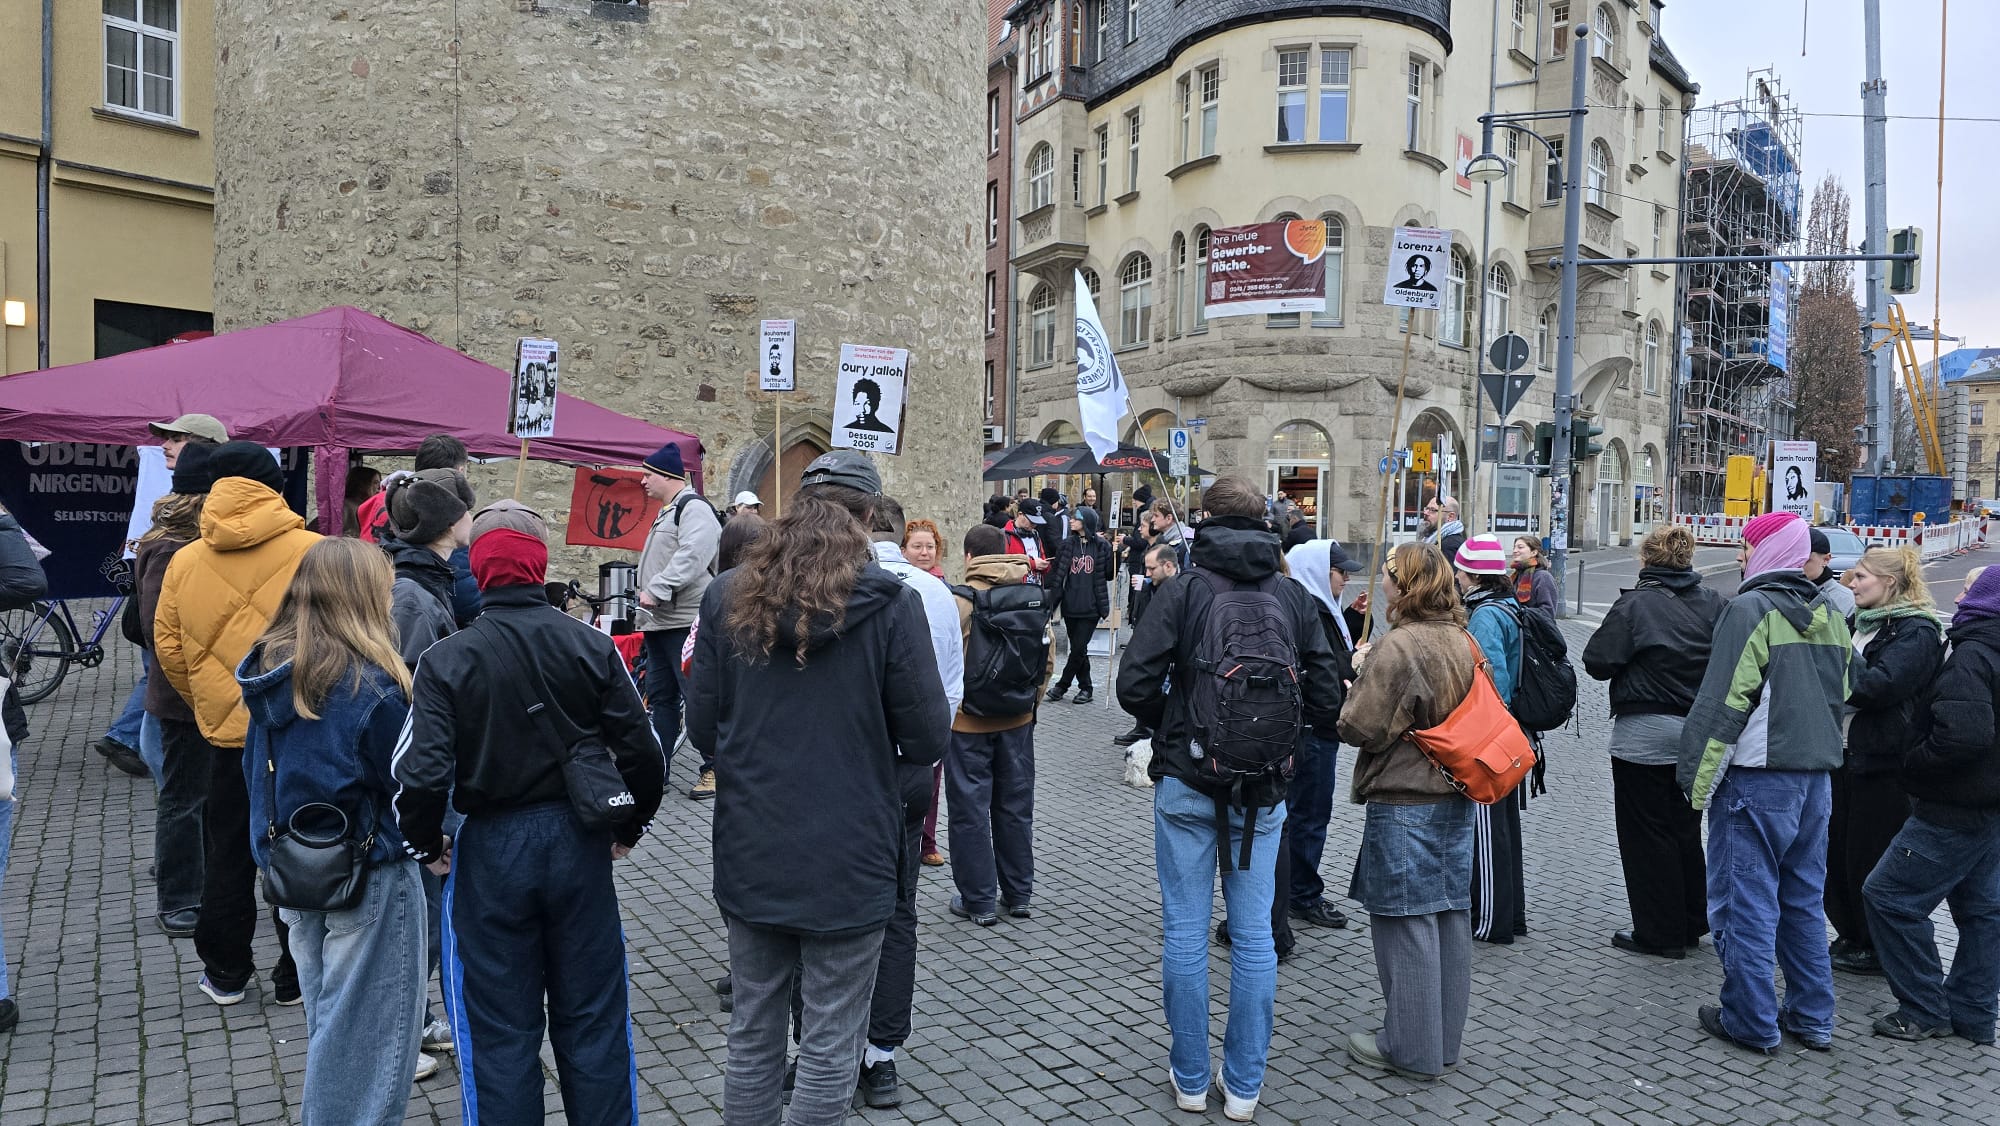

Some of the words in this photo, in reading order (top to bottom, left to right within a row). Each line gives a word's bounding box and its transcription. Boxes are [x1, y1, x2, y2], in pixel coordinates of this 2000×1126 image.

[1231, 231, 1258, 242] neue
[1211, 243, 1272, 259] Gewerbe-
[1397, 241, 1433, 252] Lorenz
[1435, 245, 1446, 253] A.
[1211, 259, 1251, 273] fläche.
[1395, 289, 1435, 299] Oldenburg
[841, 362, 869, 377] Oury
[870, 365, 903, 378] Jalloh
[848, 431, 879, 441] Dessau
[853, 440, 875, 448] 2005
[1775, 454, 1794, 462] Lamin
[1795, 455, 1815, 463] Touray
